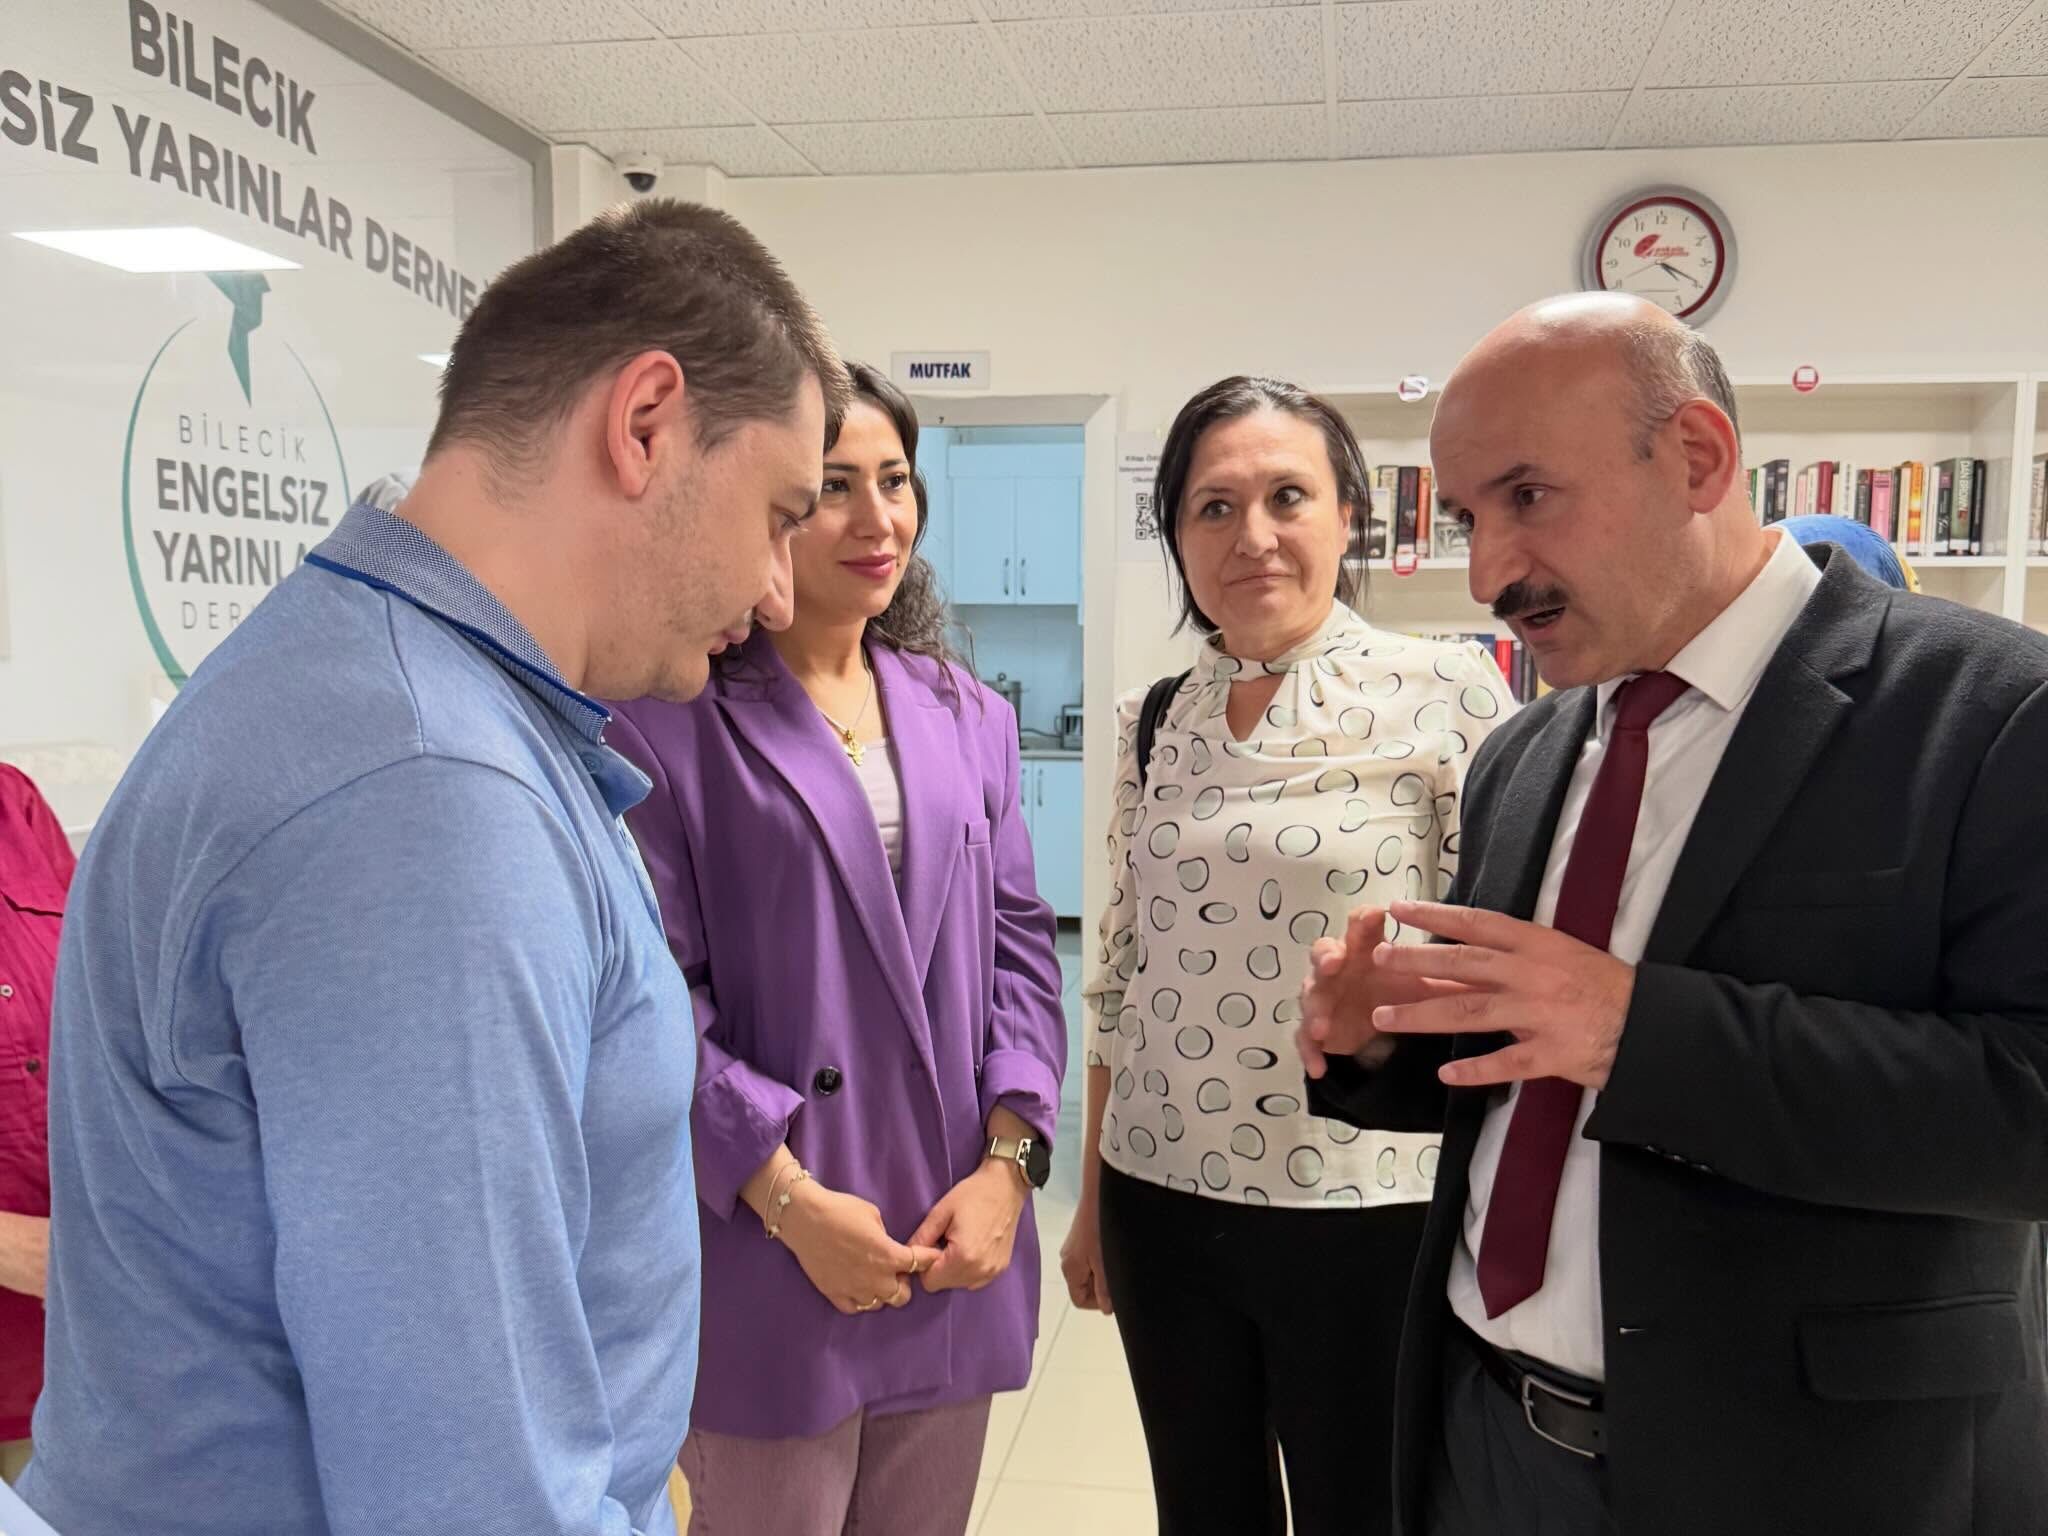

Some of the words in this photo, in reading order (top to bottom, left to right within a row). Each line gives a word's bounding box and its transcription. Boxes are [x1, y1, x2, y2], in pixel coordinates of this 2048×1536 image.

[112, 103, 353, 260] YARINLAR
[364, 216, 489, 322] DERNE
[910, 362, 971, 379] MUTFAK
[178, 413, 307, 464] BİLECİK
